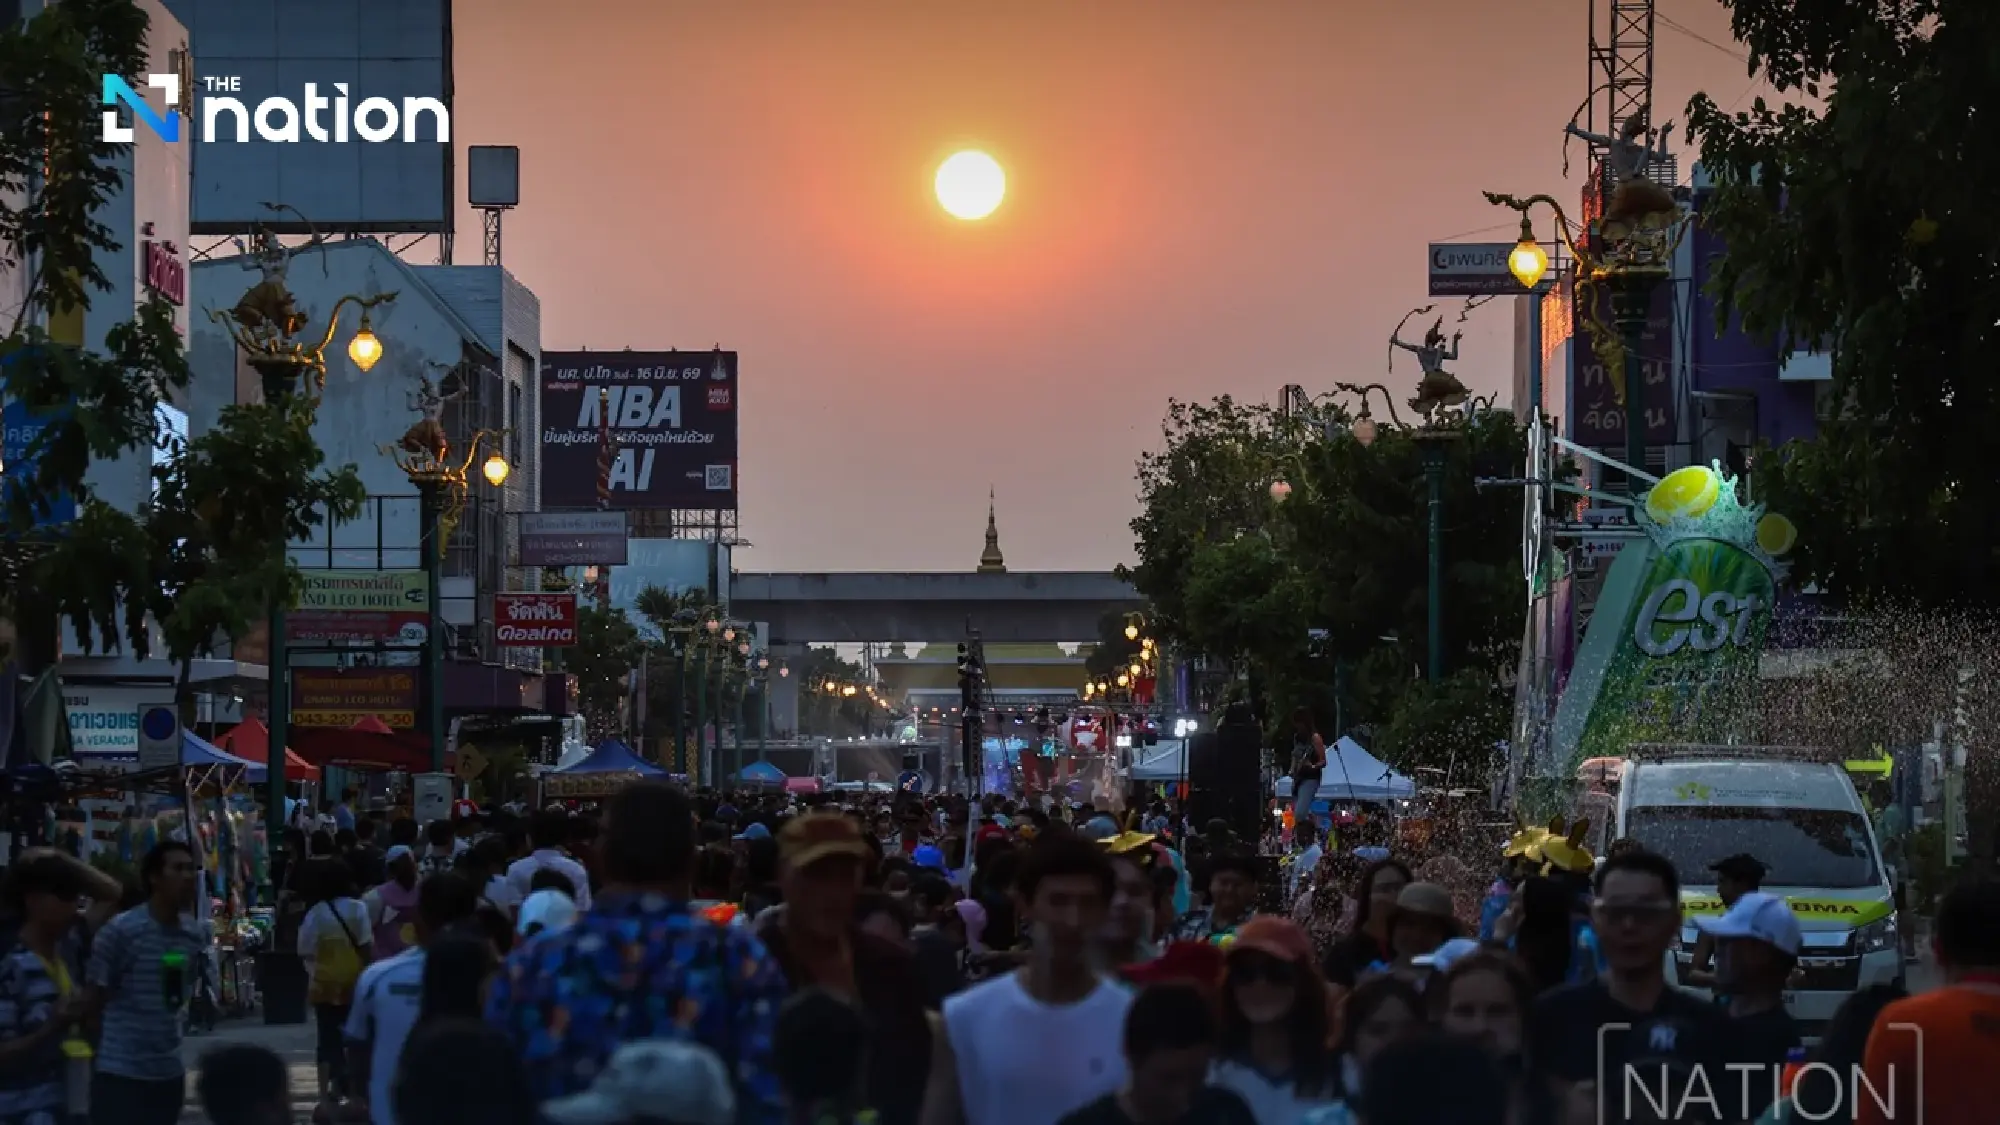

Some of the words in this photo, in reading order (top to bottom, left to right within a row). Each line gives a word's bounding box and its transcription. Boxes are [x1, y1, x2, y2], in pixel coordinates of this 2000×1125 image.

[637, 367, 652, 380] 16
[682, 367, 701, 380] 69
[577, 385, 681, 428] MBA
[608, 448, 656, 491] AI
[362, 594, 401, 606] HOTEL
[507, 599, 565, 620] จัดฟัน
[1634, 578, 1765, 658] est
[87, 735, 135, 746] VERANDA
